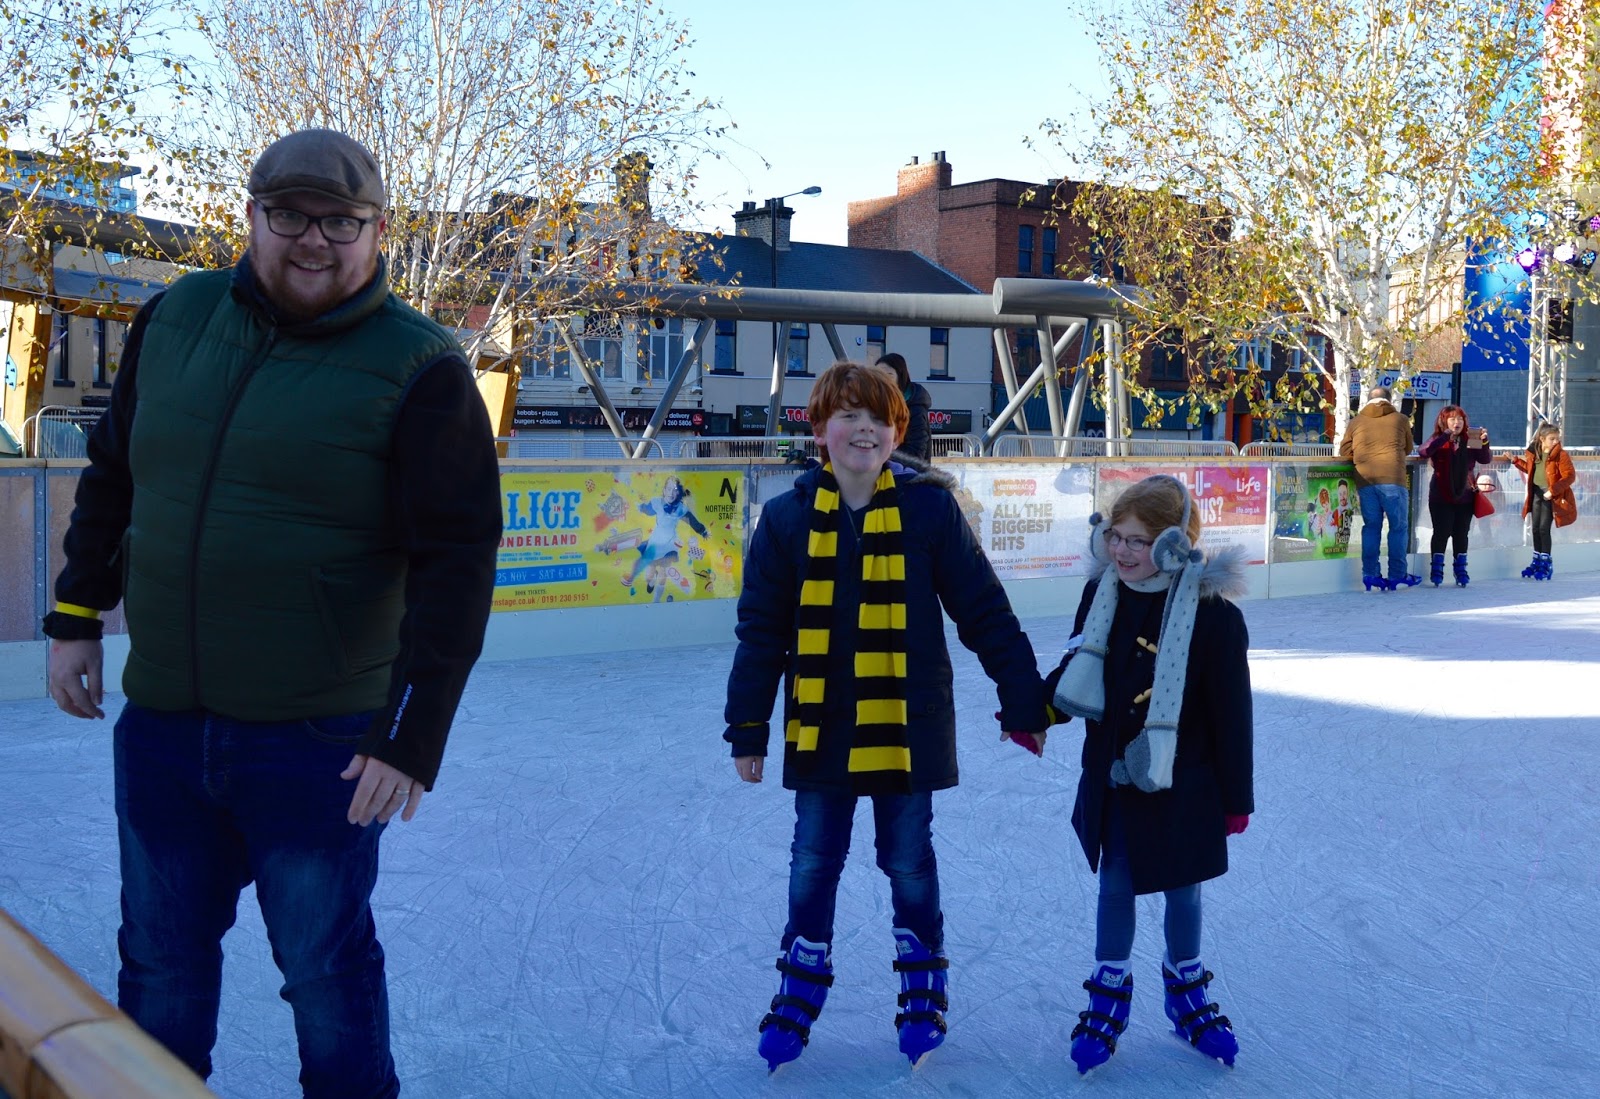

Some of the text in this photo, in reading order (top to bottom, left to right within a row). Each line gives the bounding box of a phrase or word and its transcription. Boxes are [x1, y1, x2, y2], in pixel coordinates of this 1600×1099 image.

[541, 409, 559, 417] pizzas
[1236, 476, 1261, 495] Life
[505, 491, 581, 530] LICE
[993, 503, 1053, 518] ALL THE
[1236, 506, 1261, 515] life.org.uk
[992, 519, 1053, 534] BIGGEST
[992, 536, 1025, 551] HITS
[496, 572, 507, 583] 25
[511, 571, 527, 581] NOV
[539, 569, 555, 580] SAT
[559, 569, 564, 577] 6
[567, 567, 583, 578] JAN
[541, 595, 557, 603] 0191
[560, 594, 572, 602] 230
[573, 593, 589, 601] 5151
[1101, 976, 1119, 986] aren
